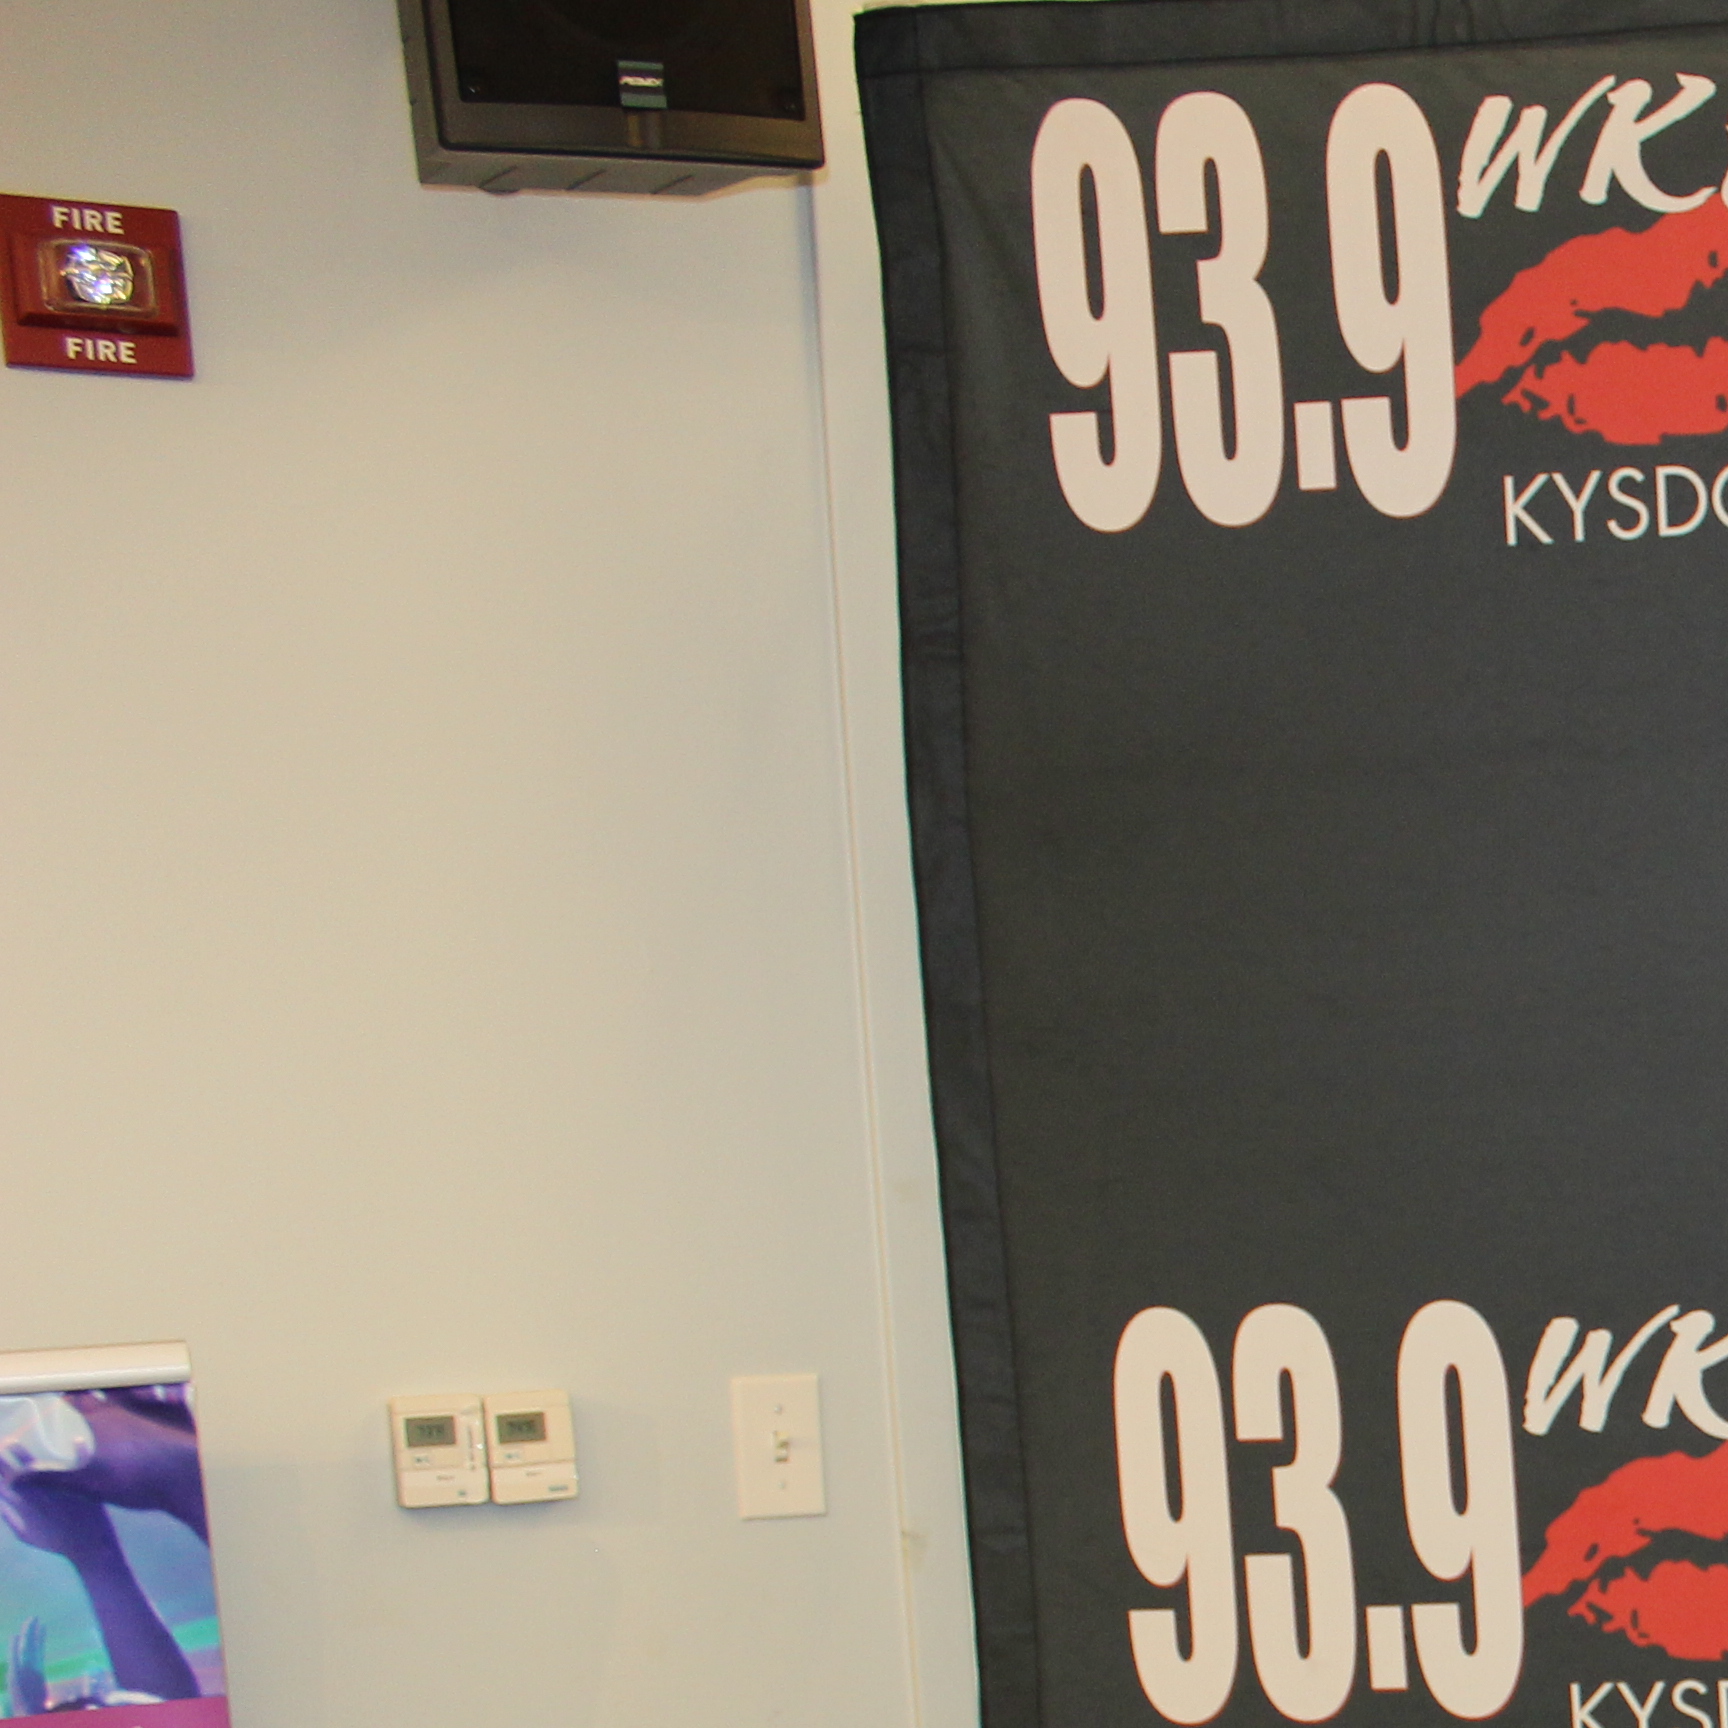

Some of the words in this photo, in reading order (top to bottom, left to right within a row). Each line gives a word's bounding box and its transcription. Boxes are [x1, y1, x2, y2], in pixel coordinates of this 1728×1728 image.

[51, 205, 125, 235] FIRE
[1032, 83, 1457, 532] 93.9
[65, 337, 138, 364] FIRE
[1114, 1300, 1525, 1724] 93.9
